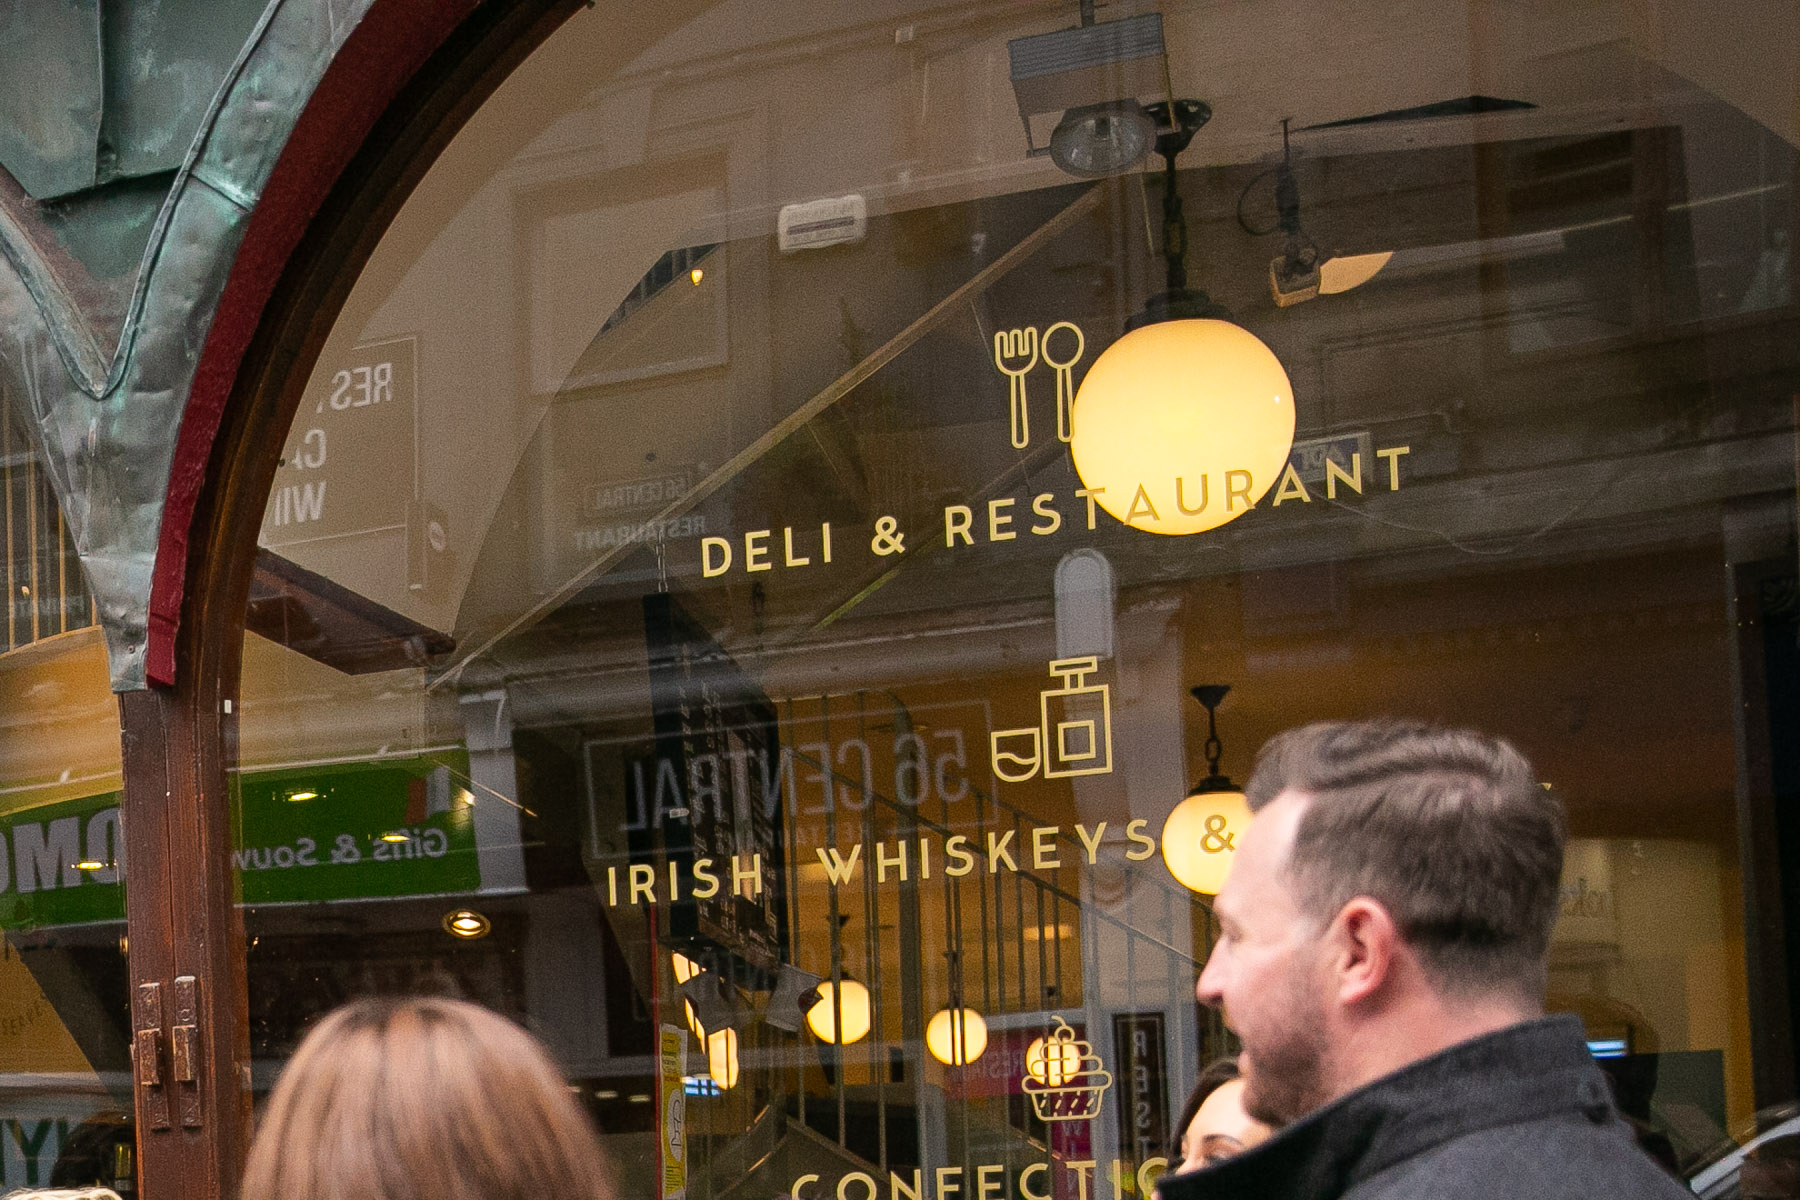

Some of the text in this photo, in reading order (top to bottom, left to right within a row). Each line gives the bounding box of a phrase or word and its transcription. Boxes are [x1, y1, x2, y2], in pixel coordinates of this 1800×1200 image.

[702, 523, 833, 578] DELI
[871, 515, 907, 556] &
[944, 446, 1411, 549] RESTAURANT
[607, 814, 1235, 907] IRISH WHISKEYS &
